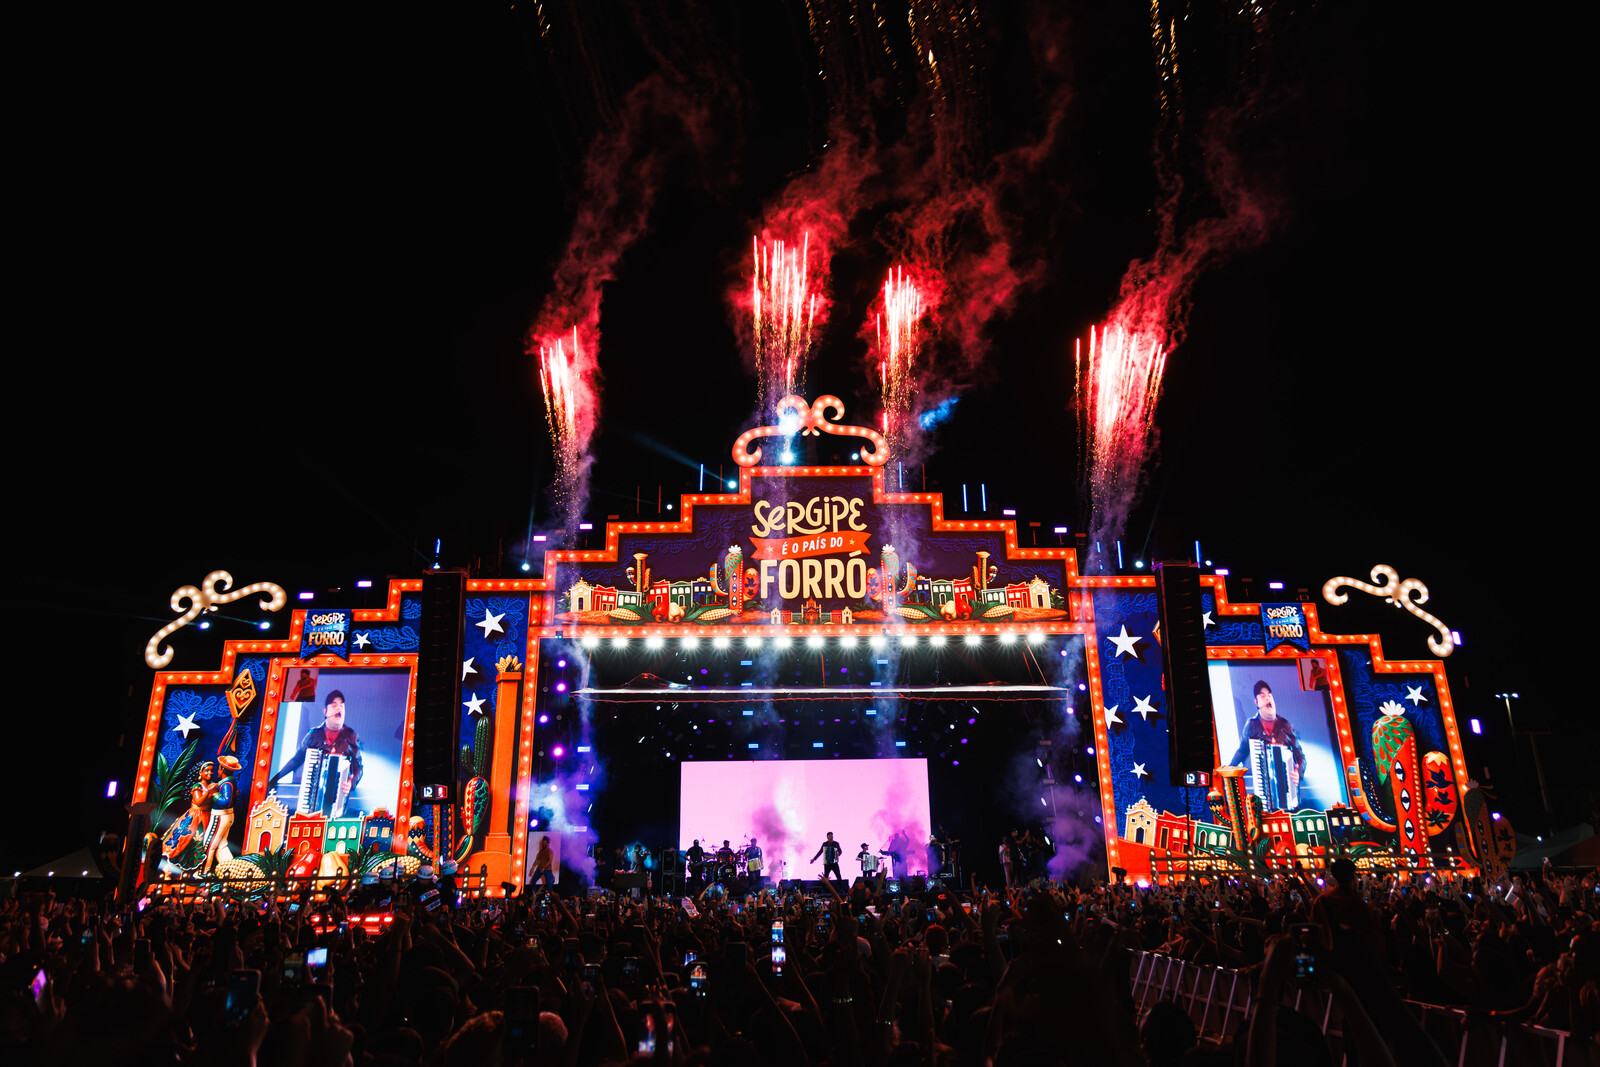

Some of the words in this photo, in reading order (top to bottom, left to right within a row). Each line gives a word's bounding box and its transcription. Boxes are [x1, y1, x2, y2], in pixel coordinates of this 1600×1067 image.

[782, 541, 788, 555] É
[792, 542, 799, 554] O
[802, 537, 826, 552] PAÍS
[830, 536, 843, 548] DO
[760, 549, 867, 599] FORRÓ
